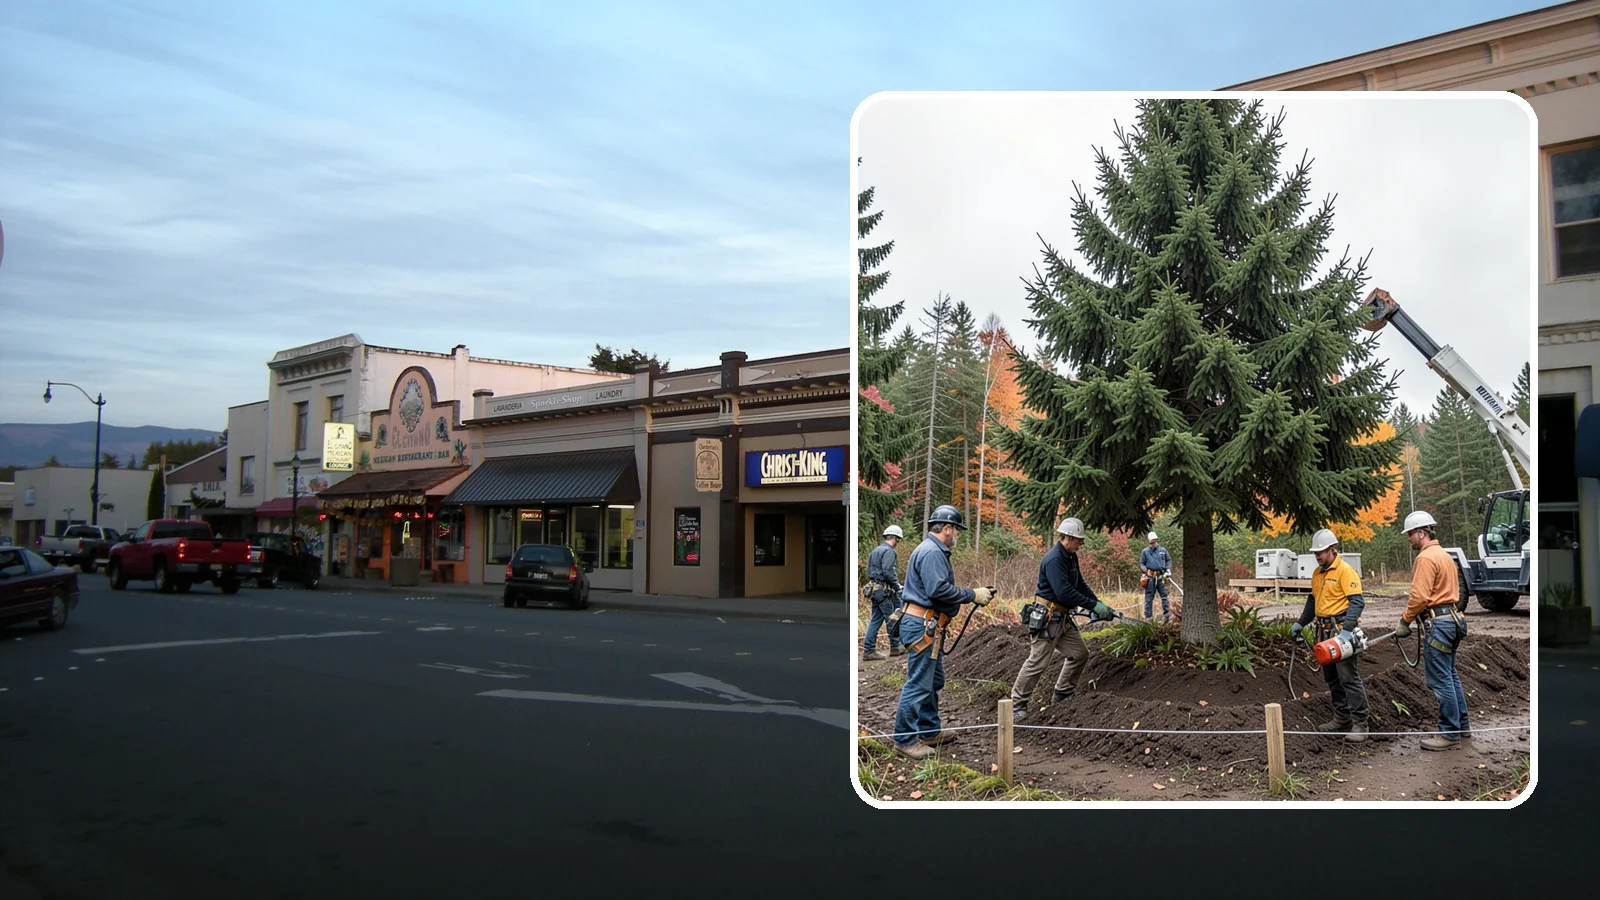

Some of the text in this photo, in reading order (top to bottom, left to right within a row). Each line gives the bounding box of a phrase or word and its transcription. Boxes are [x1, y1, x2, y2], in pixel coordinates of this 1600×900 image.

[595, 389, 623, 400] LAUNDRY
[493, 402, 523, 413] LAVANDERIA
[530, 394, 582, 409] Sparkle Shop
[374, 455, 396, 464] MEXICAN
[397, 451, 433, 462] RESTAURANT
[437, 450, 450, 459] BAR
[761, 450, 827, 478] CHRIST KING
[696, 480, 709, 489] Coffee
